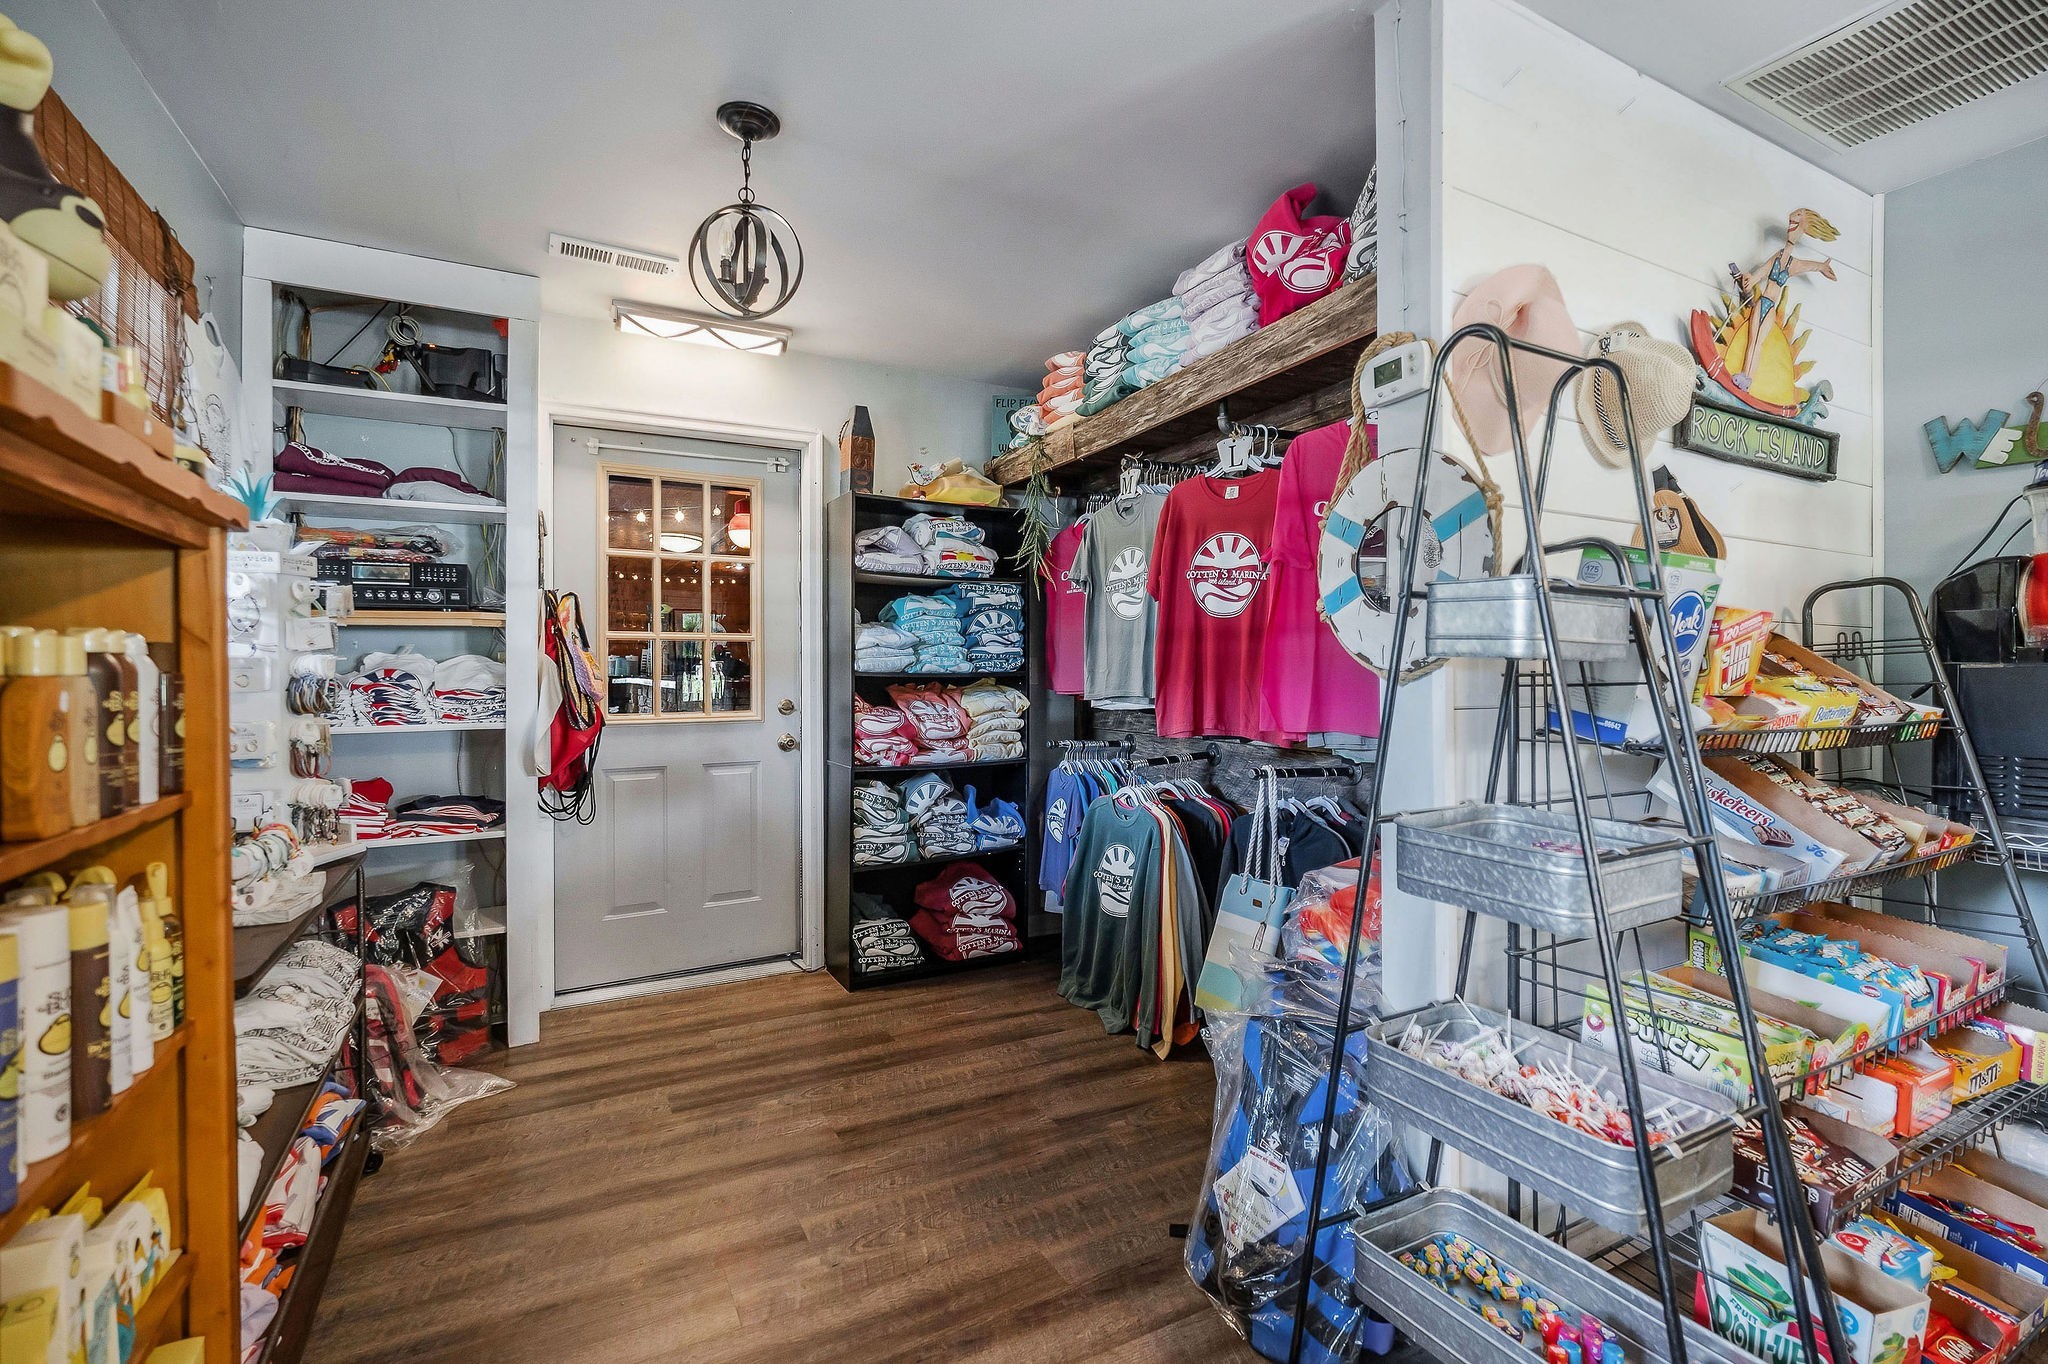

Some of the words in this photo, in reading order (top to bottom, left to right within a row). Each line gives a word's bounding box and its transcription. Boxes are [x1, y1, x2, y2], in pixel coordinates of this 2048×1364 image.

[996, 399, 1017, 408] FLIP
[1690, 405, 1750, 453] ROCK
[1754, 424, 1826, 468] ISLAND
[1229, 445, 1244, 468] L
[1121, 474, 1136, 494] M
[1186, 568, 1228, 580] COTTEN'S
[1231, 570, 1268, 581] MARINA
[1723, 626, 1740, 643] 120
[984, 926, 1012, 937] MARINA
[1729, 1297, 1760, 1325] FRUIT
